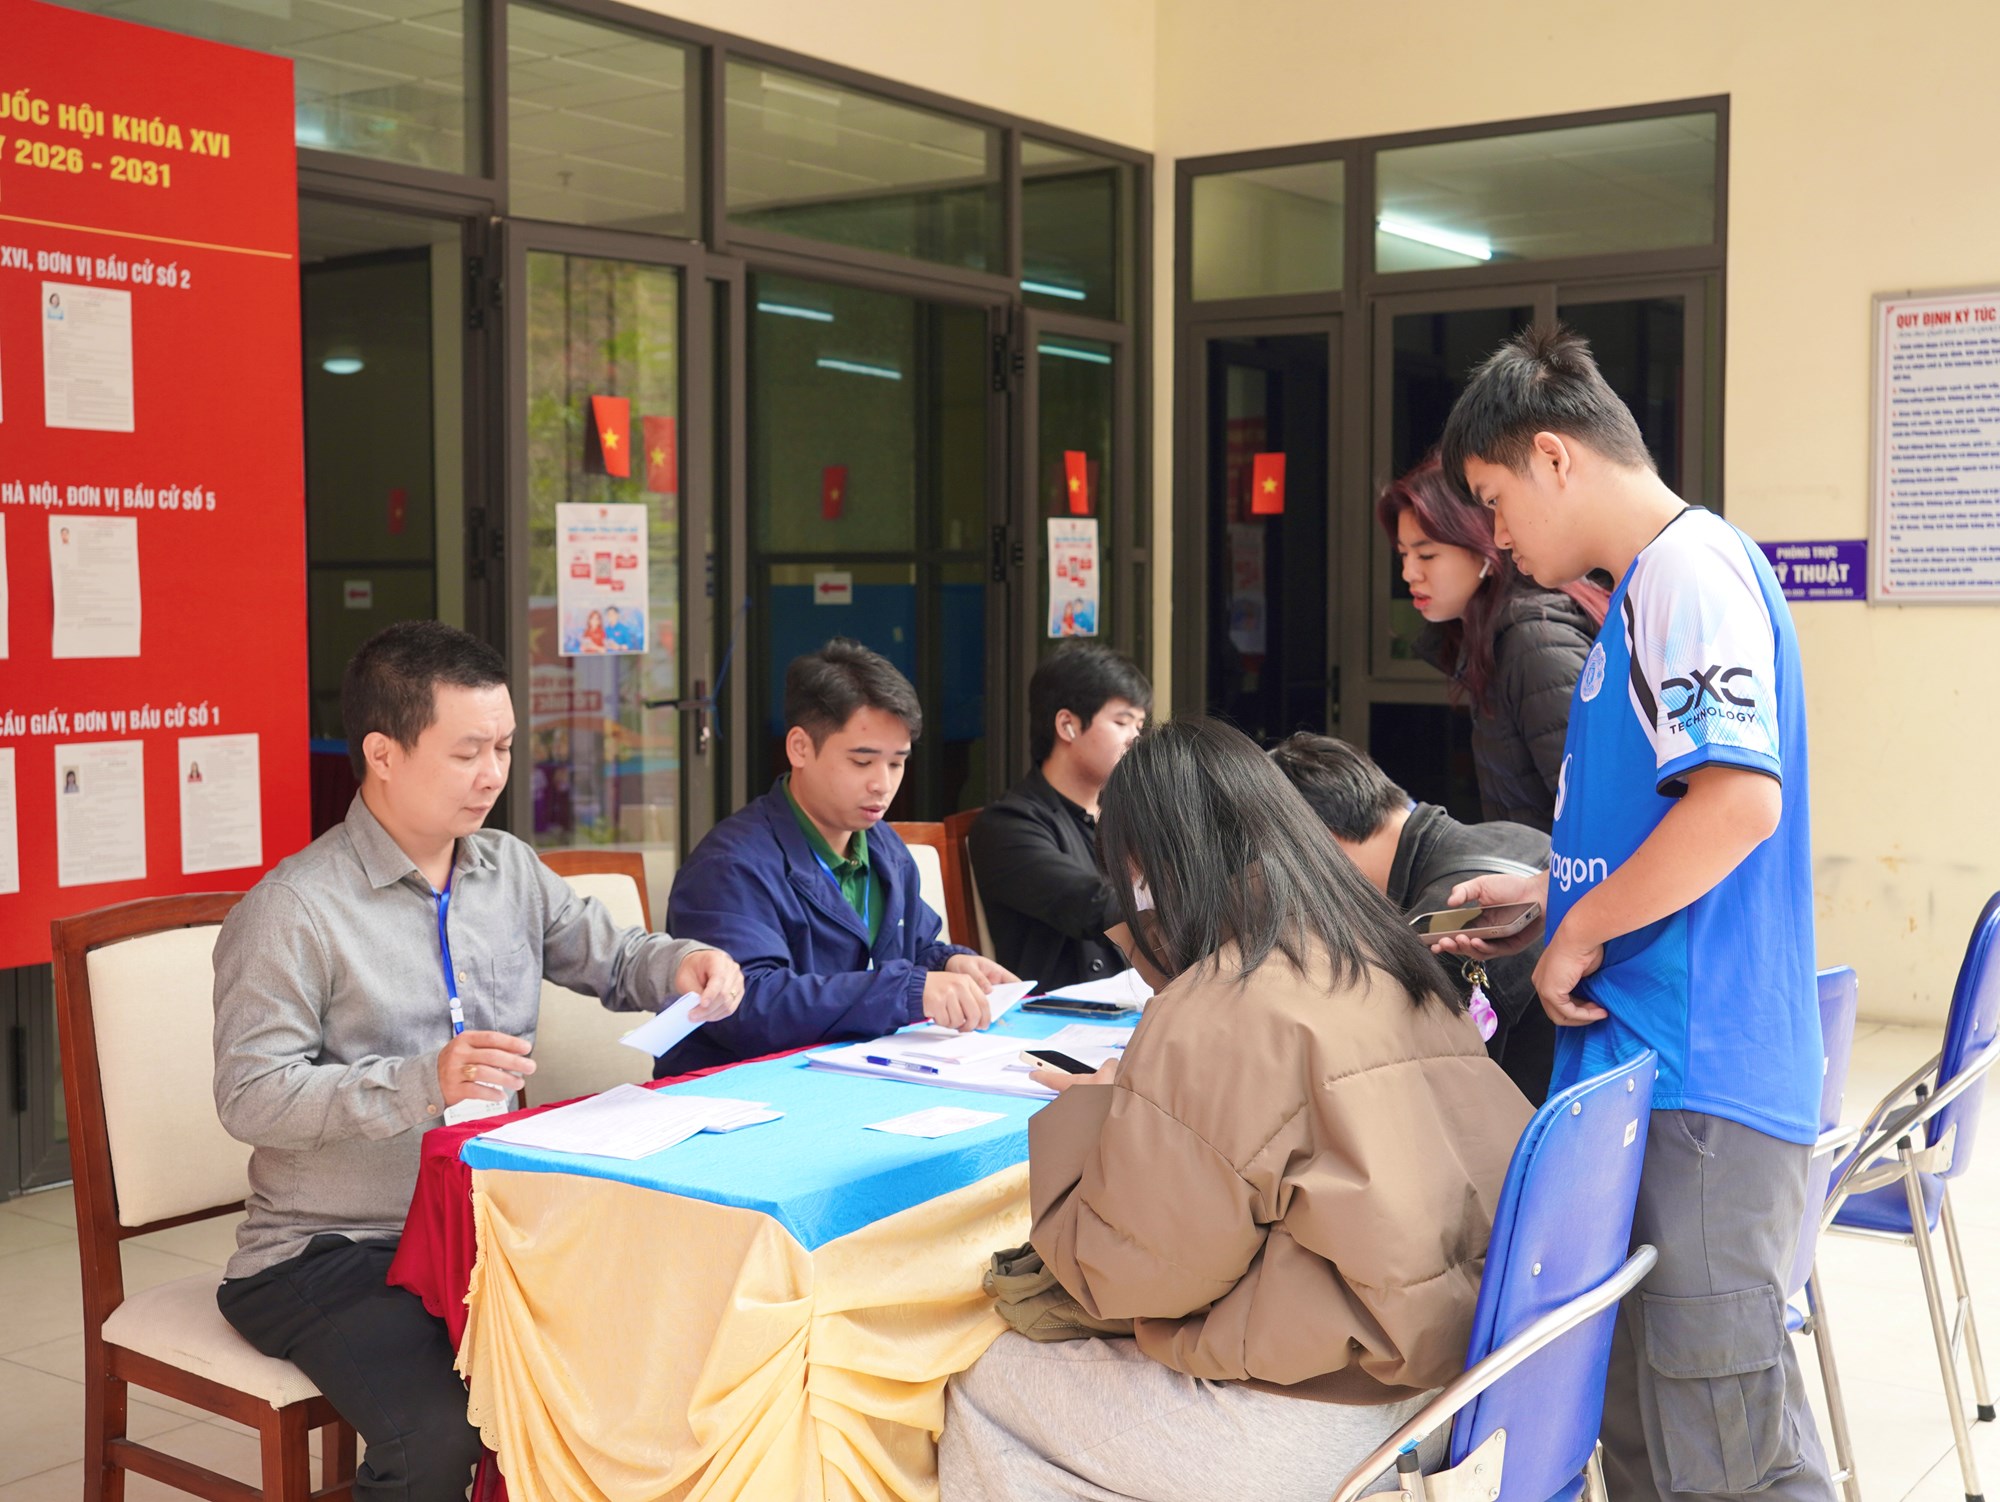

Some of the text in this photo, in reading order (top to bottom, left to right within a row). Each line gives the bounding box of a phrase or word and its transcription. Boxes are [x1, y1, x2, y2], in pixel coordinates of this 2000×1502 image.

[0, 88, 230, 158] UỐC HỘI KHÓA XVI
[15, 139, 84, 174] 2026
[91, 162, 103, 170] -
[110, 156, 170, 188] 2031
[0, 246, 34, 272] XVI,
[36, 251, 73, 275] ĐƠN
[75, 256, 92, 282] VỊ
[131, 259, 155, 285] CỬ
[156, 262, 178, 288] SỐ
[180, 270, 191, 290] 2
[1897, 305, 1996, 328] QUY ĐỊNH KÝ TÚC
[1, 480, 26, 505] HÀ
[28, 481, 64, 510] NỘI,
[66, 485, 101, 507] ĐƠN
[103, 488, 120, 512] VỊ
[157, 484, 181, 510] CỬ
[181, 485, 203, 511] SỐ
[205, 492, 216, 511] 5
[1792, 561, 1849, 586] THUẬT
[1661, 664, 1755, 720] DXC
[30, 708, 71, 736] GIẤY,
[73, 711, 108, 733] ĐƠN
[110, 711, 127, 735] VỊ
[163, 703, 187, 729] CỬ
[187, 701, 209, 727] SỐ
[211, 707, 220, 726] 1
[1670, 707, 1755, 734] TECHNOLOGY
